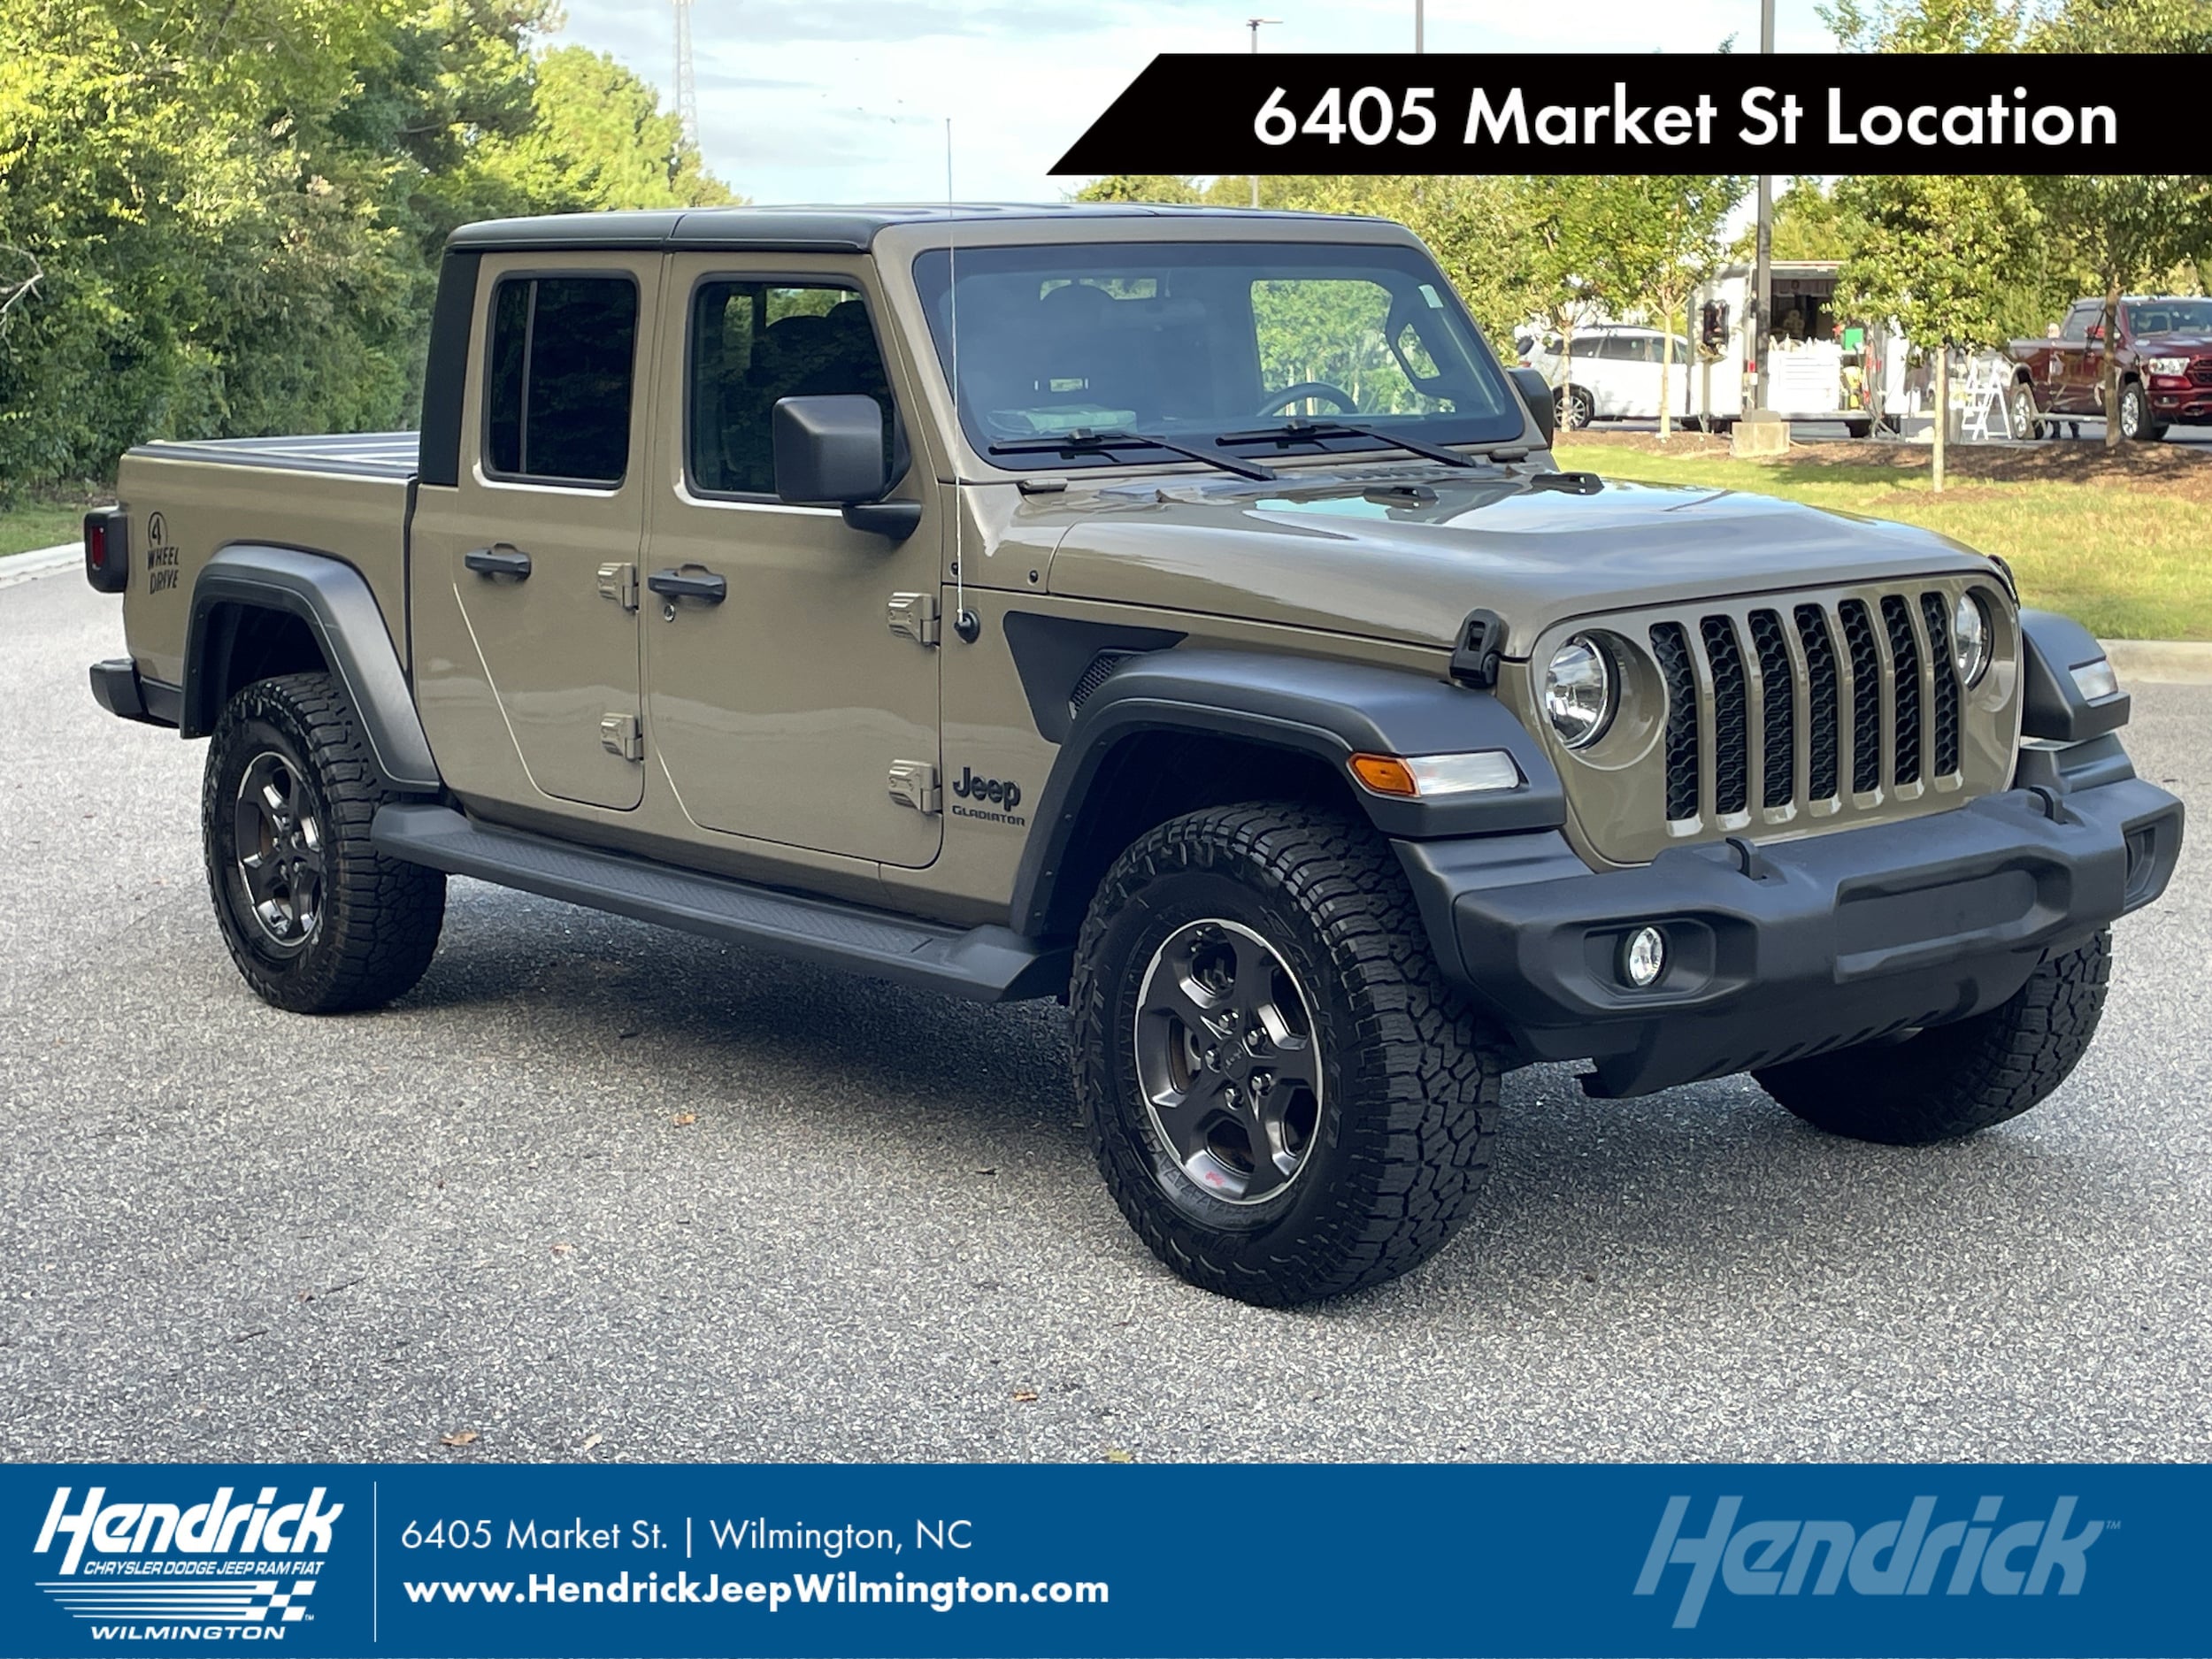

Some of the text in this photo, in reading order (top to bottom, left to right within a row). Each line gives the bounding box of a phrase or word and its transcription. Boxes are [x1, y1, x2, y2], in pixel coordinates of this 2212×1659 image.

[148, 547, 180, 570] WHEEL
[150, 571, 180, 595] DRIVE
[952, 766, 1021, 811] Jeep
[951, 804, 1026, 826] GLADIATOR
